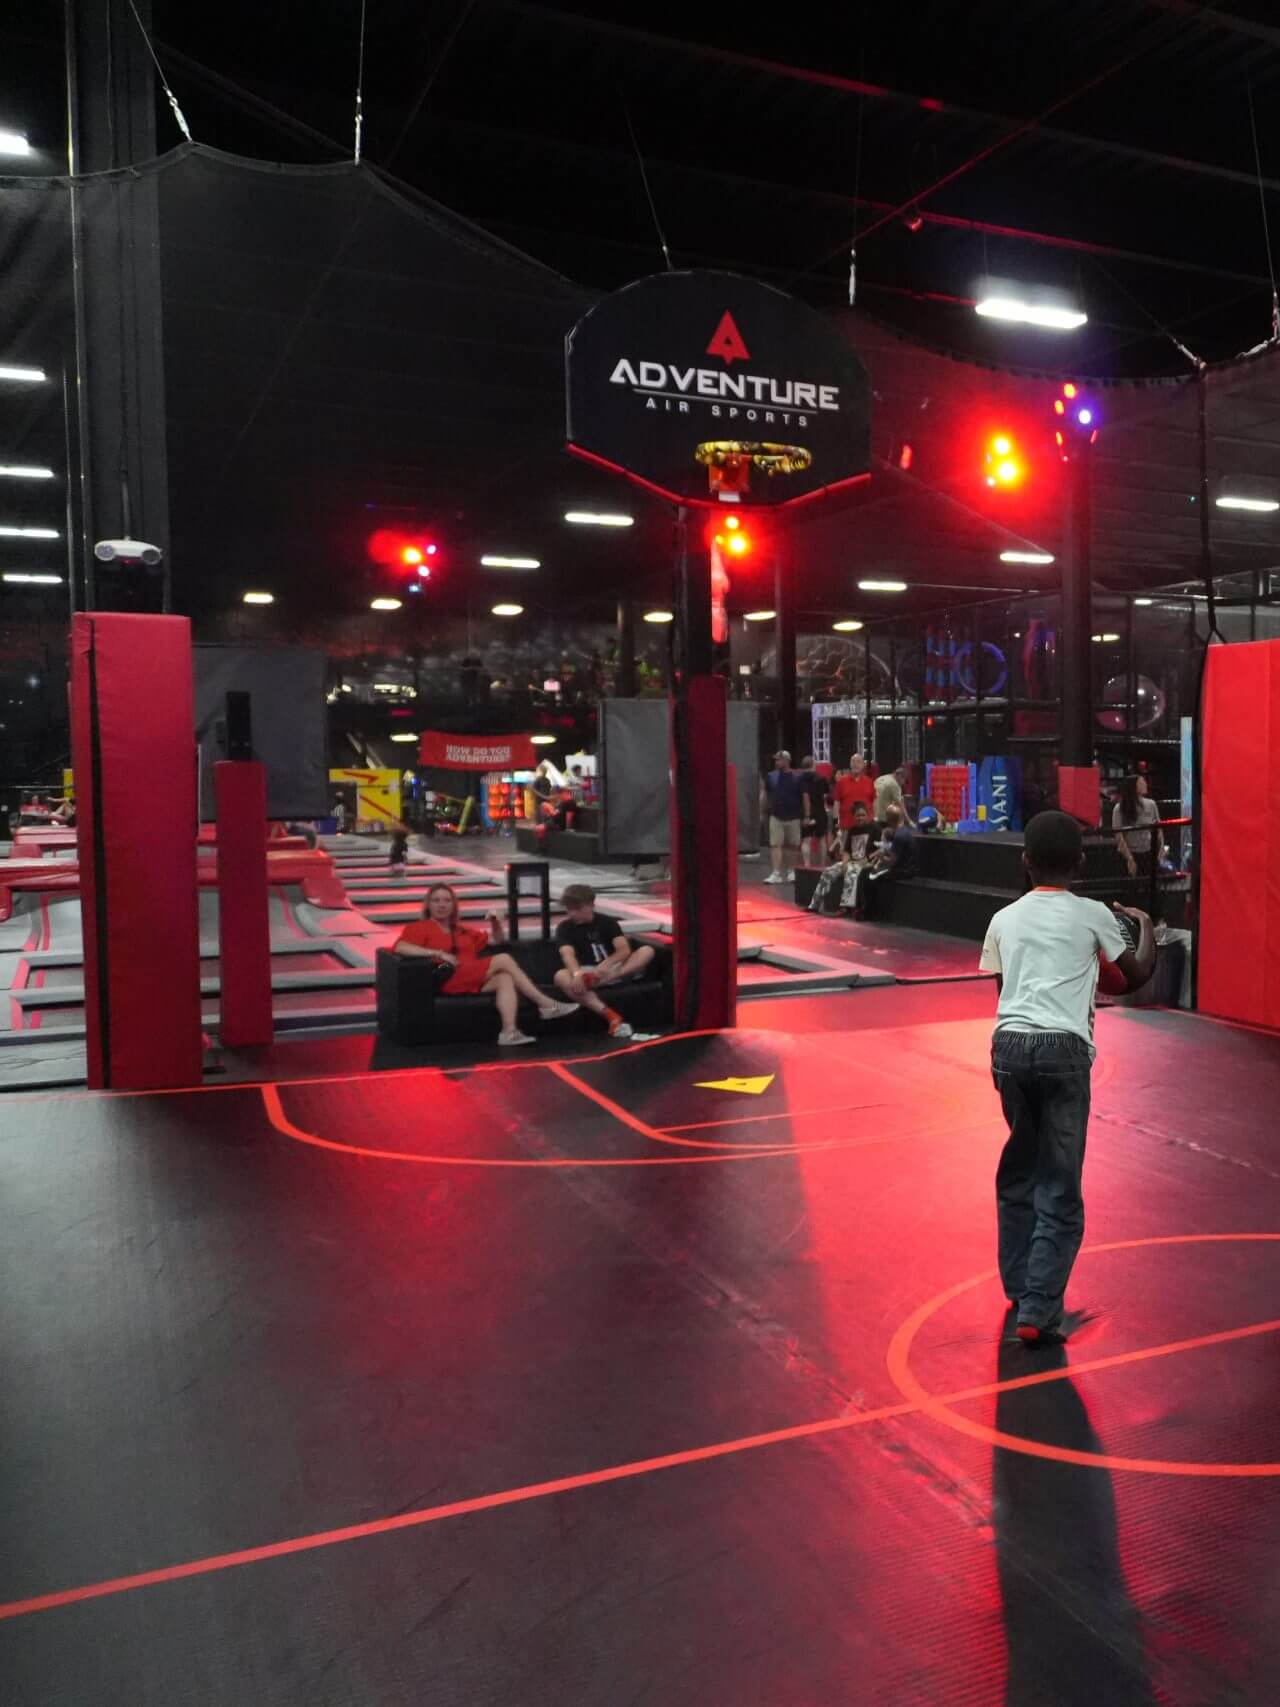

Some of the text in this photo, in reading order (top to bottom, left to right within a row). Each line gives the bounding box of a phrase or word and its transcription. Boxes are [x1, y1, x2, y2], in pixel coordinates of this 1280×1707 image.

[609, 358, 839, 410] ADVENTURE
[645, 397, 807, 427] AIR SPORTS
